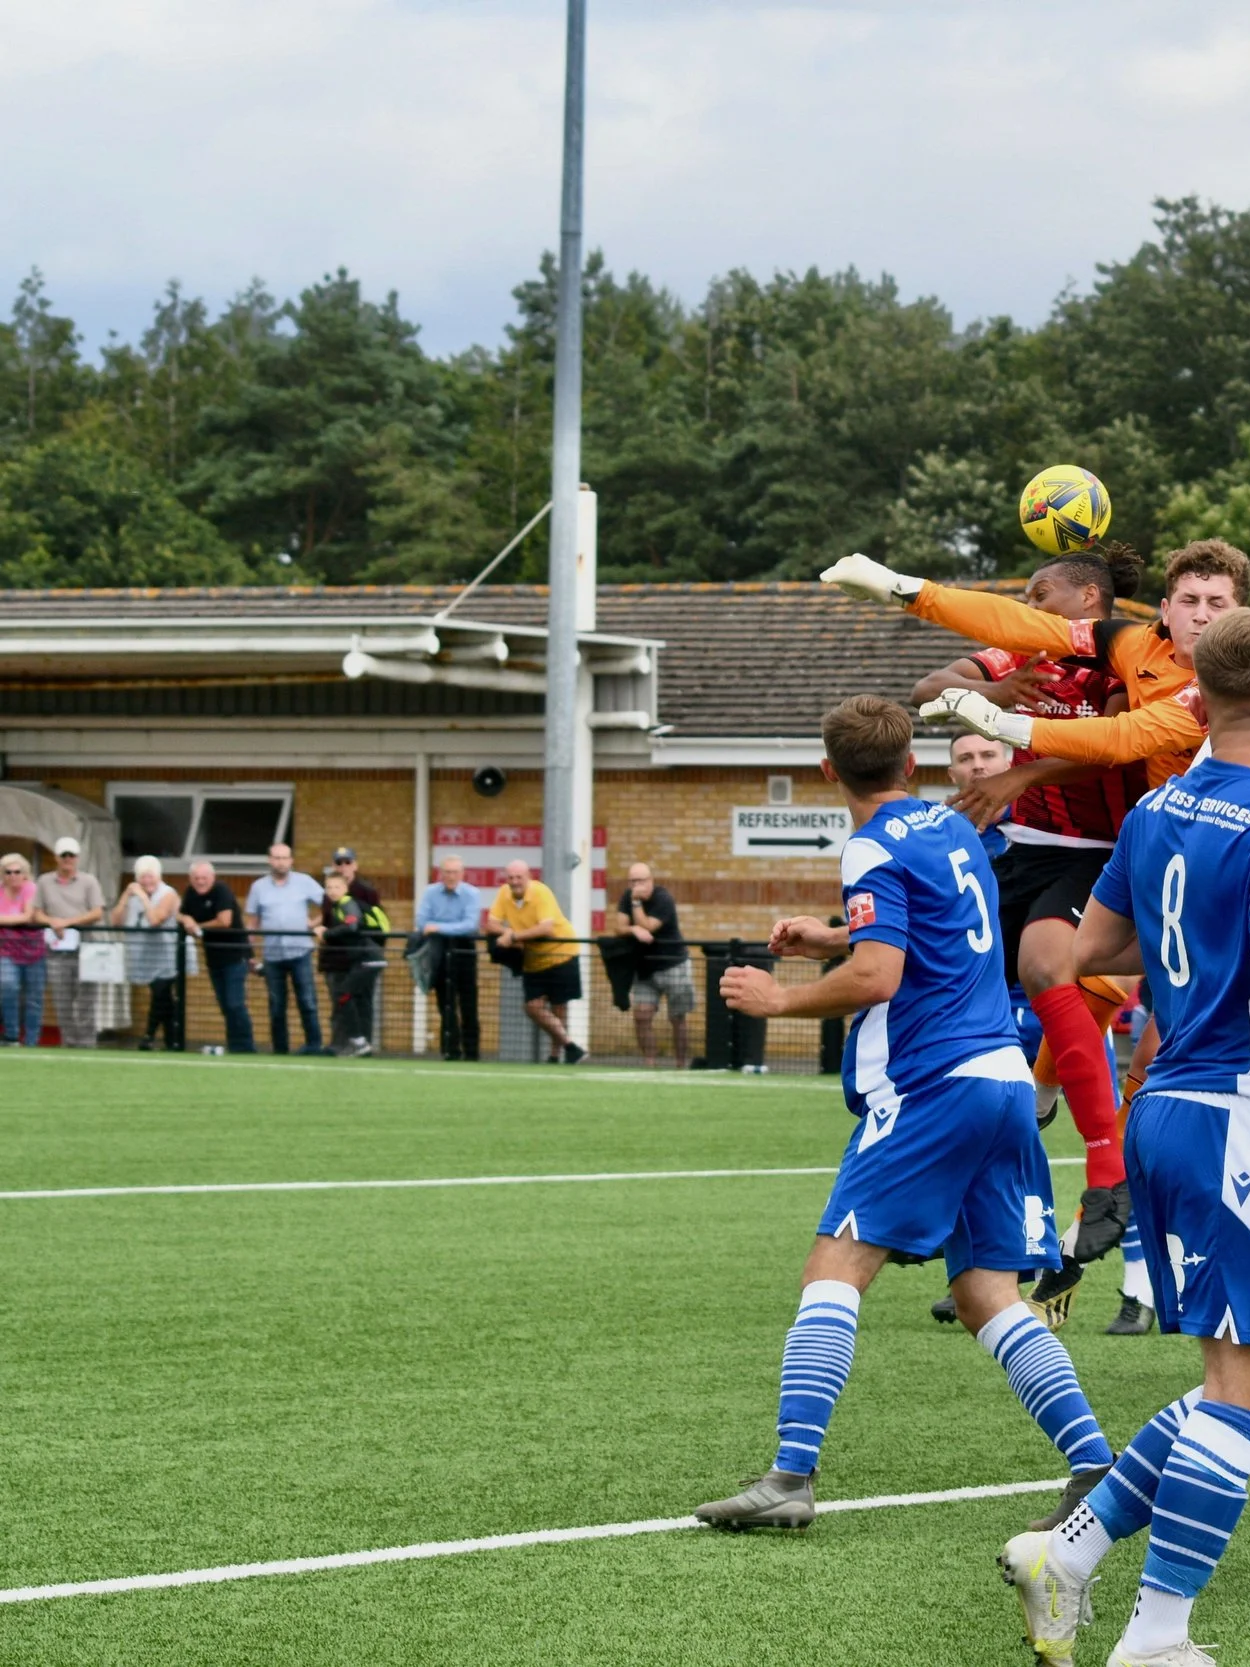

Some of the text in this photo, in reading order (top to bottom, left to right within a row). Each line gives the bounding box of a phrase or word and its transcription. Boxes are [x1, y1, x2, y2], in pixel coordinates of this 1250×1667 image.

[1073, 493, 1089, 521] mitre
[738, 811, 846, 829] REFRESHMENTS
[948, 847, 993, 954] 5
[1160, 853, 1190, 988] 8
